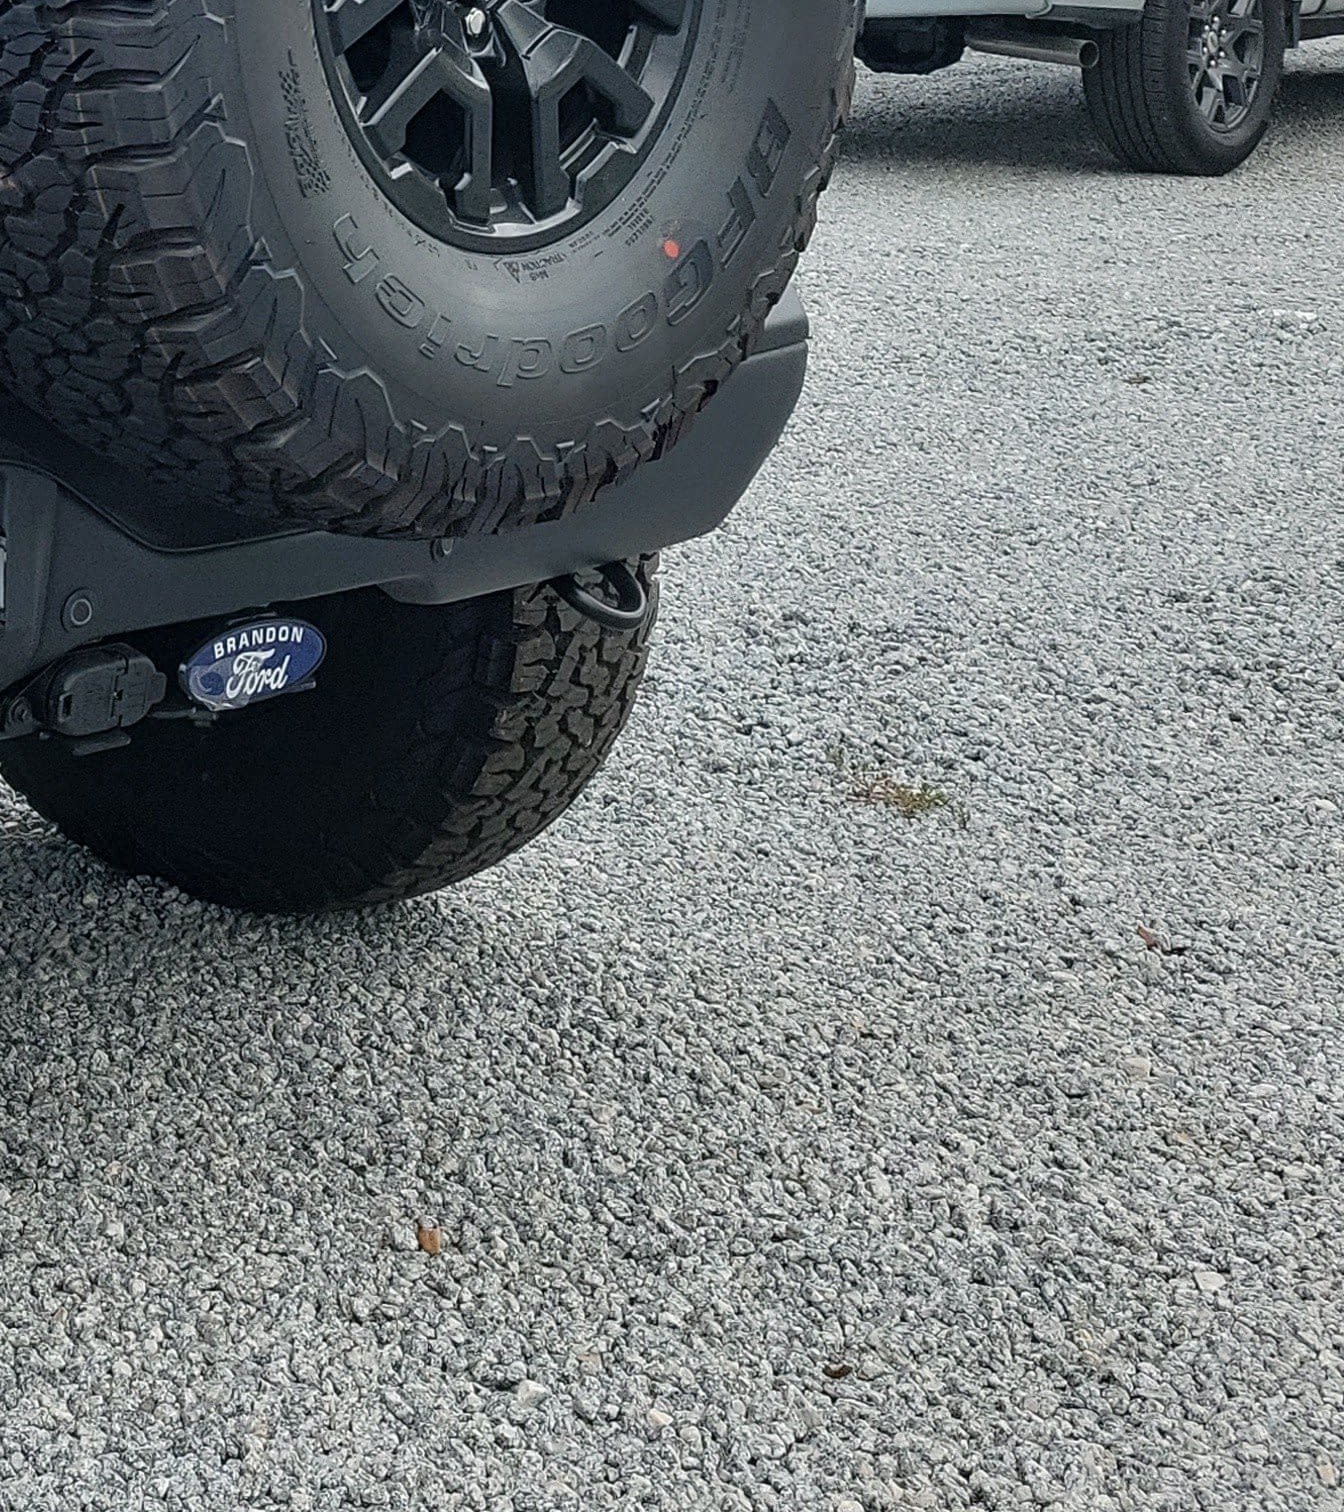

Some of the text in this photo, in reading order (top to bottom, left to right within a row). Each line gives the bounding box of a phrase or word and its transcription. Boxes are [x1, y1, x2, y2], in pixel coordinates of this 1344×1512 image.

[332, 98, 791, 388] BFGoodrich
[213, 625, 304, 659] BRANDON
[226, 648, 291, 699] Ford
